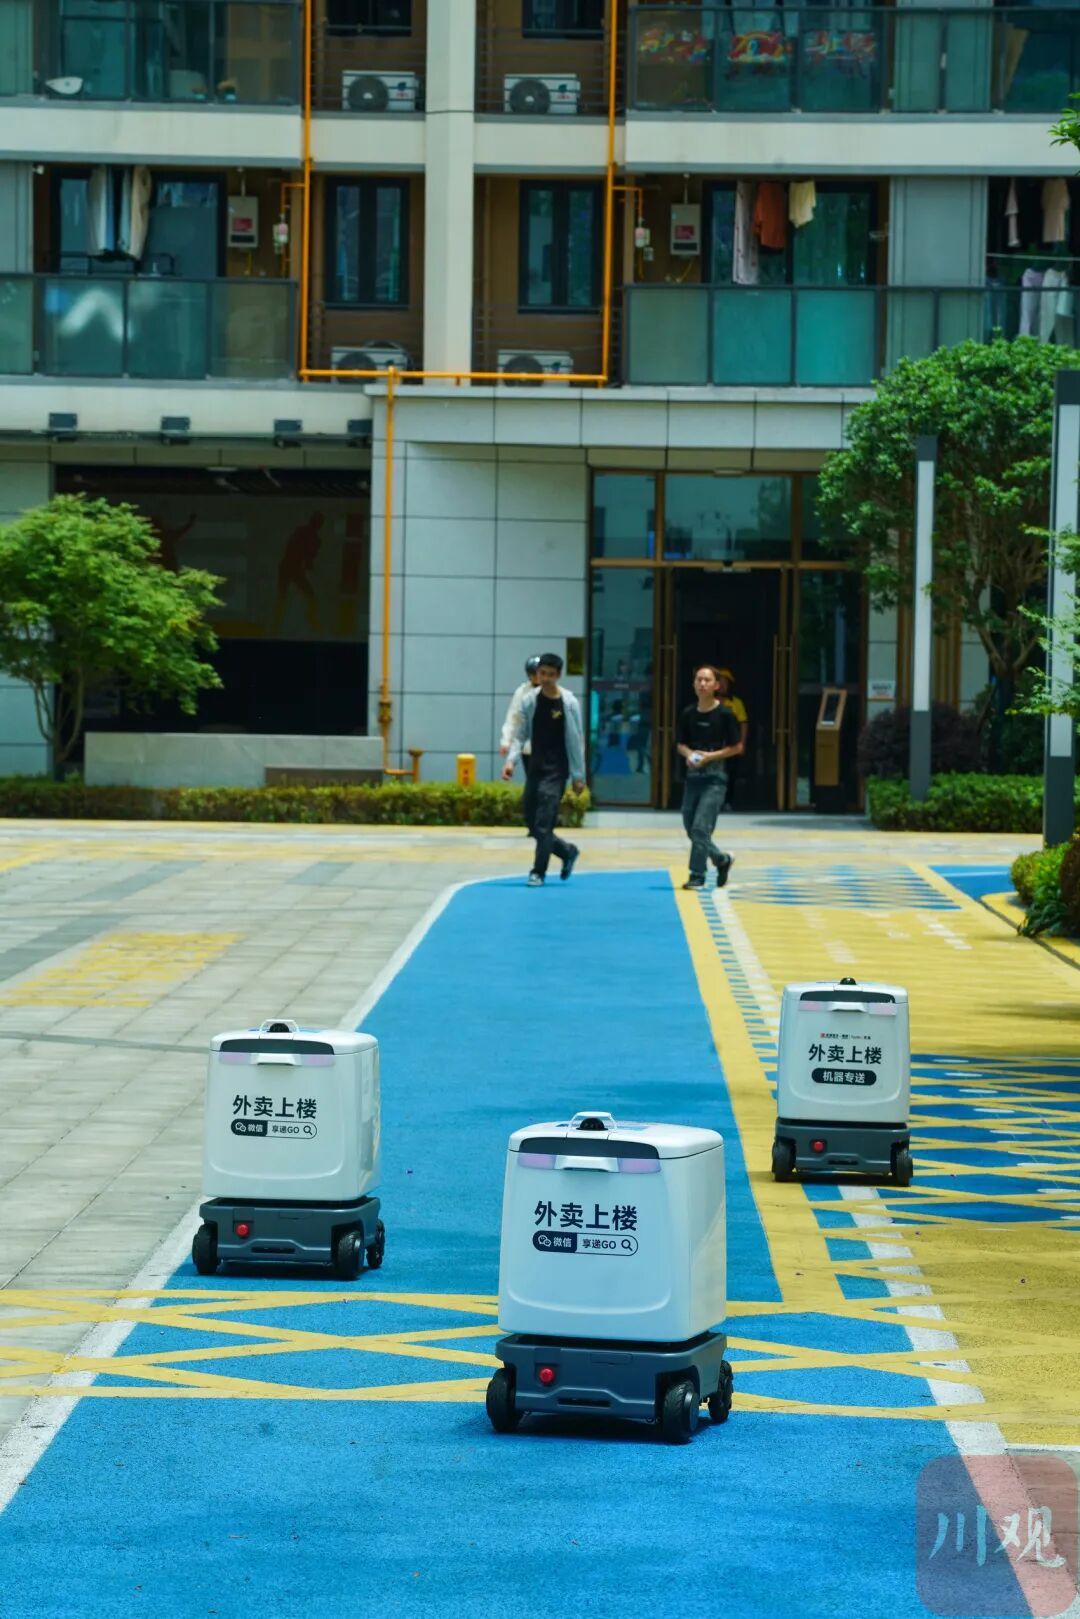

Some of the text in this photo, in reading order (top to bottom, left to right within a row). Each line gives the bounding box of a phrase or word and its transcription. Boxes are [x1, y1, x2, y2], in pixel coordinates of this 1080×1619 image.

[808, 1043, 882, 1065] 外卖上楼
[822, 1070, 865, 1083] 机器专送
[232, 1094, 317, 1119] 外卖上楼
[247, 1123, 263, 1133] 微信
[534, 1200, 637, 1231] 外卖上楼
[553, 1237, 617, 1250] 微信 享递GO
